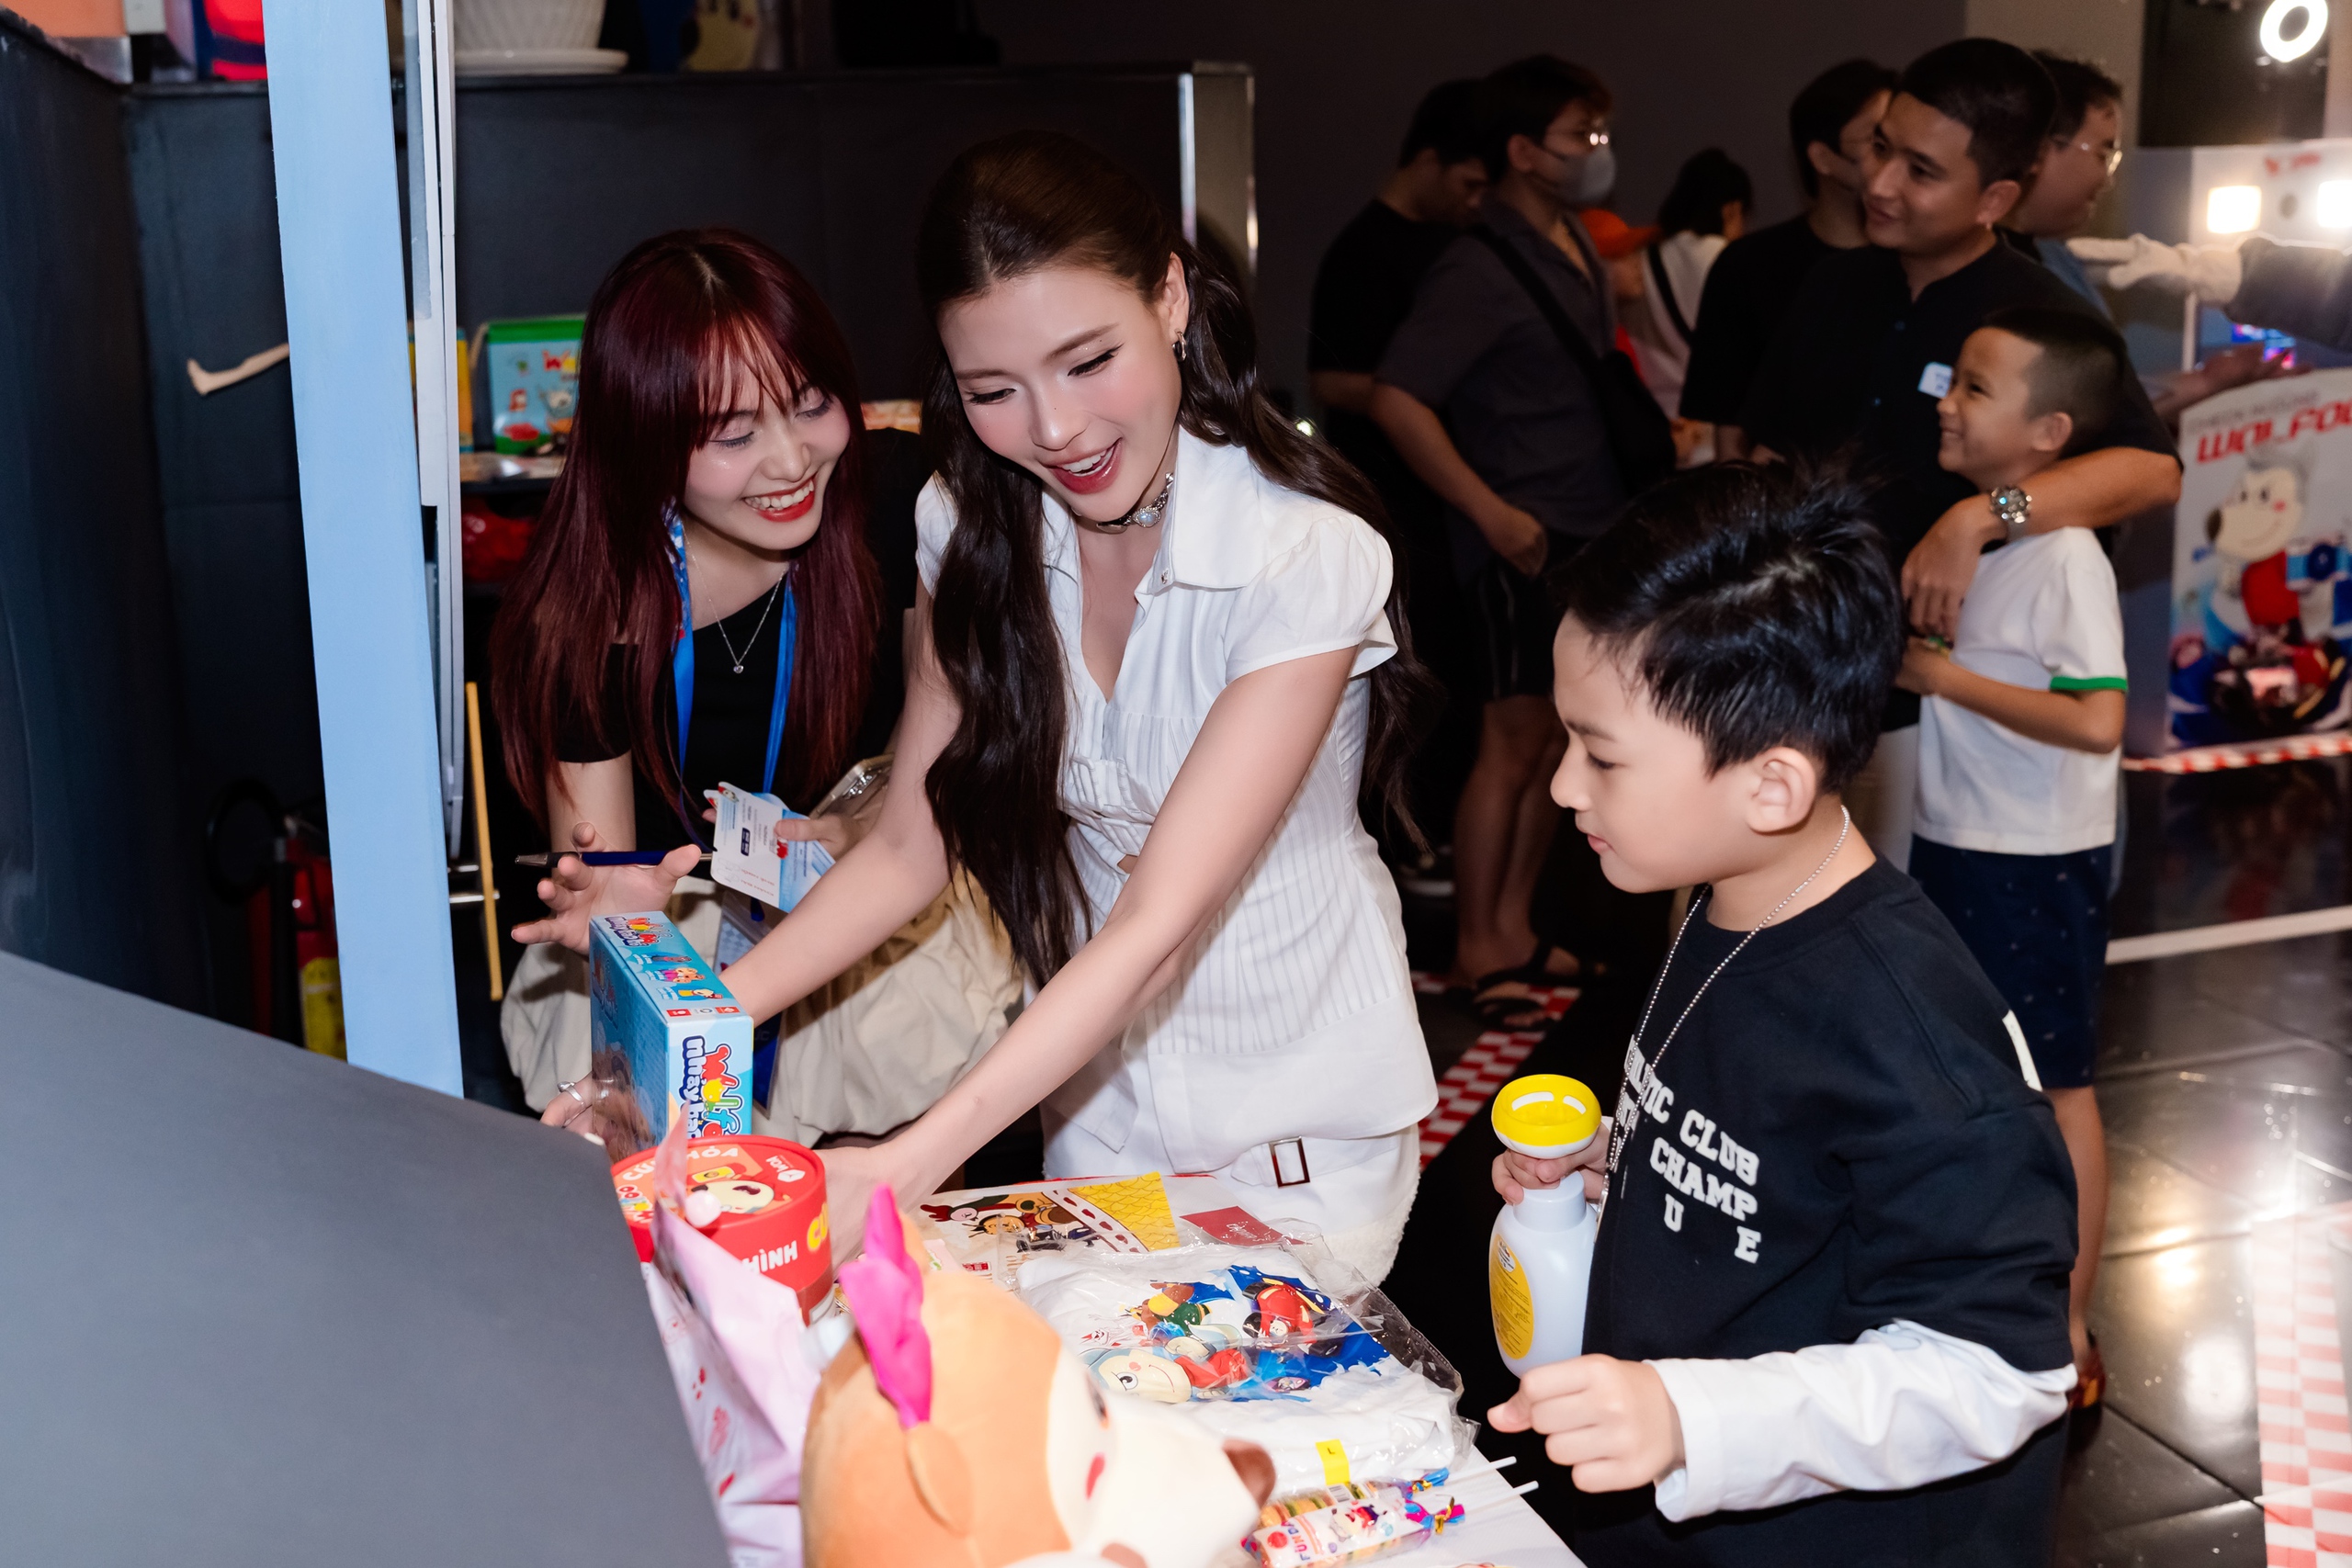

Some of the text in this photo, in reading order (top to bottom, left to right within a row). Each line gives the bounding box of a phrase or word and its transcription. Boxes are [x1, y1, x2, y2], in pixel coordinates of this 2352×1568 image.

[1650, 1136, 1758, 1222] CHAMP
[1679, 1109, 1759, 1186] CLUB
[1664, 1193, 1761, 1264] U E
